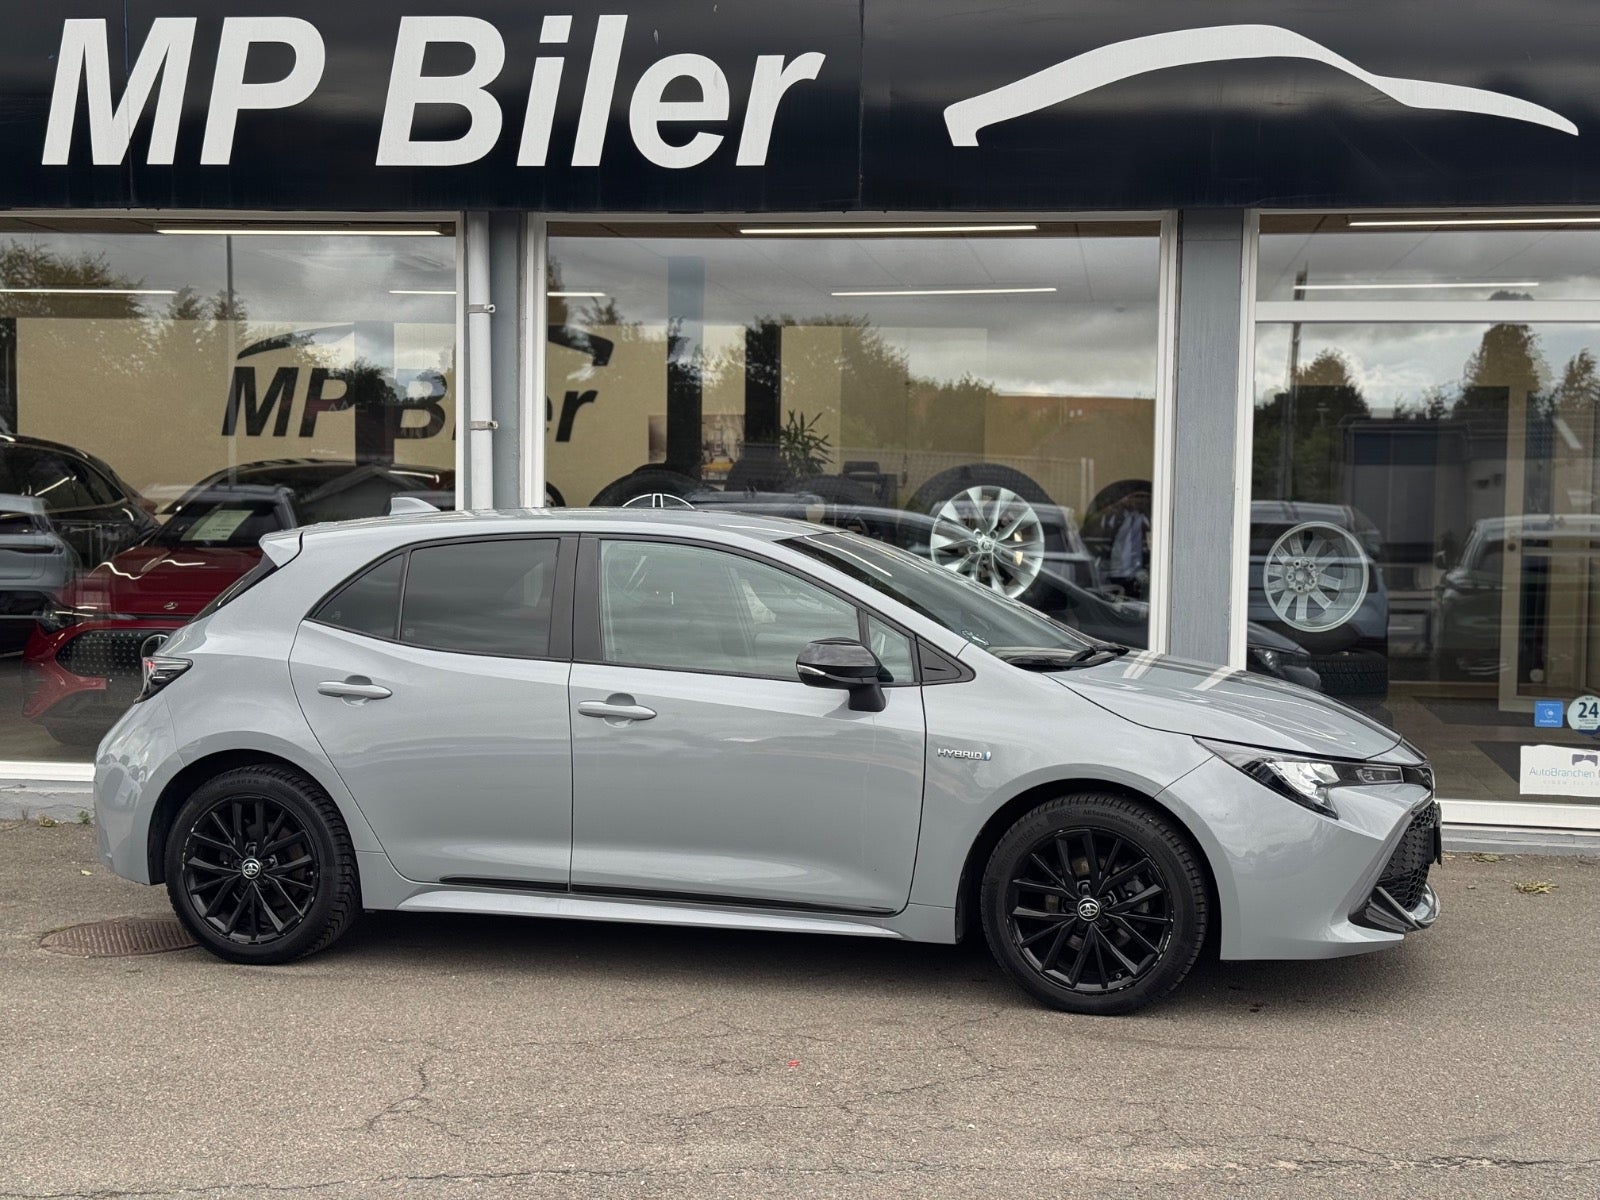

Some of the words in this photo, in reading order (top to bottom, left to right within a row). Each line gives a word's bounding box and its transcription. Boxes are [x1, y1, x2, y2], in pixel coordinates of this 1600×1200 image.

[42, 15, 326, 167] MP
[375, 14, 827, 169] Biler
[222, 366, 360, 438] MP
[1578, 702, 1599, 718] 24
[937, 748, 982, 760] HYBRID
[1529, 766, 1595, 778] AutoBranchen
